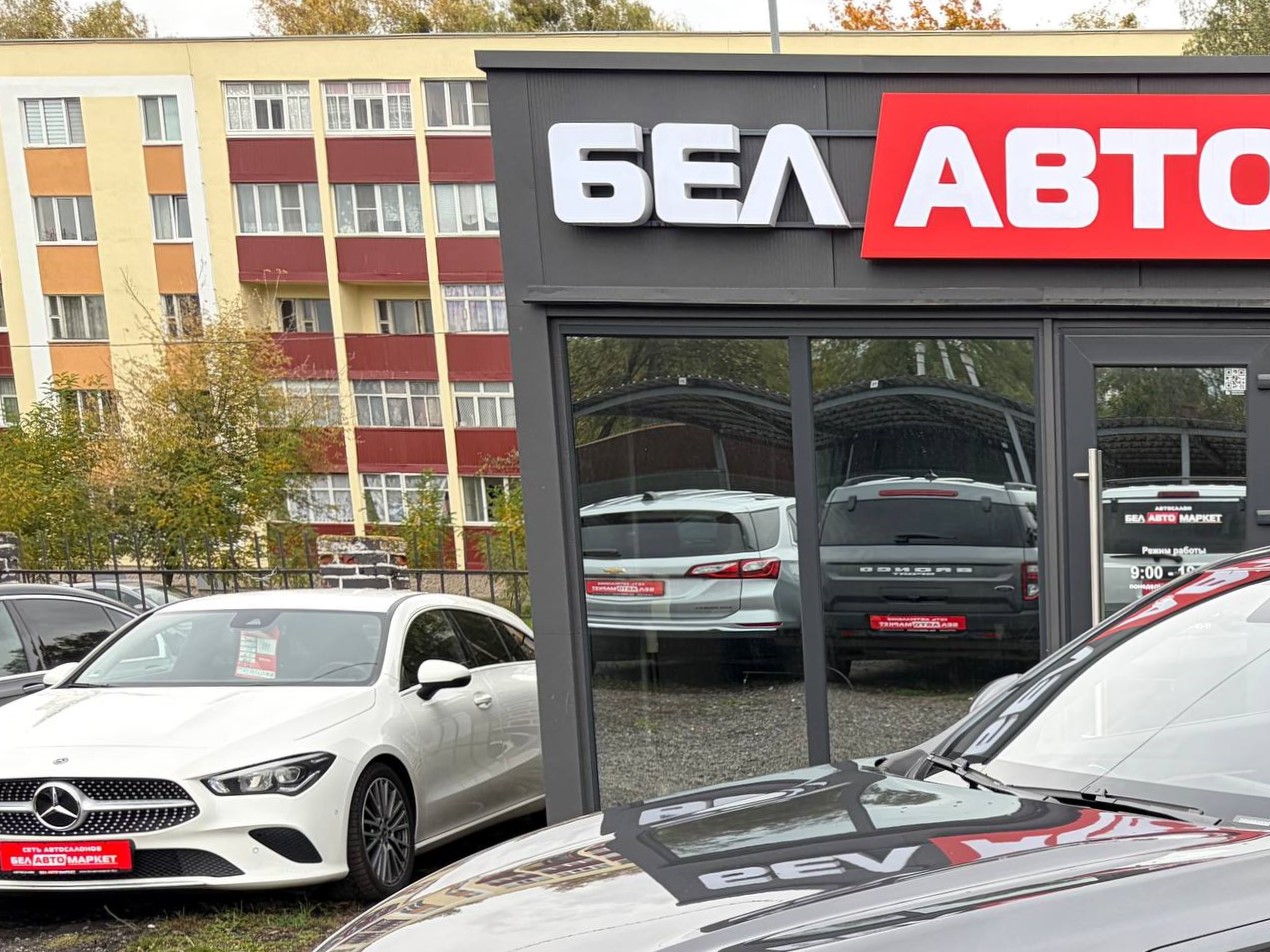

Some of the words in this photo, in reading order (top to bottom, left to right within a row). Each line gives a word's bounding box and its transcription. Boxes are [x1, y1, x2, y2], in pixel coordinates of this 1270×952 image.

[548, 122, 851, 228] БЕЛ
[1125, 514, 1145, 523] БЕЛ
[1148, 514, 1176, 522] АВТО
[1179, 514, 1223, 523] МАРКЕТ
[1142, 546, 1171, 554] Режим
[1173, 546, 1206, 556] работы
[1130, 566, 1163, 579] 9:00
[10, 856, 31, 865] БЕЛ
[35, 856, 65, 864] АВТО
[67, 855, 118, 864] МАРКЕТ
